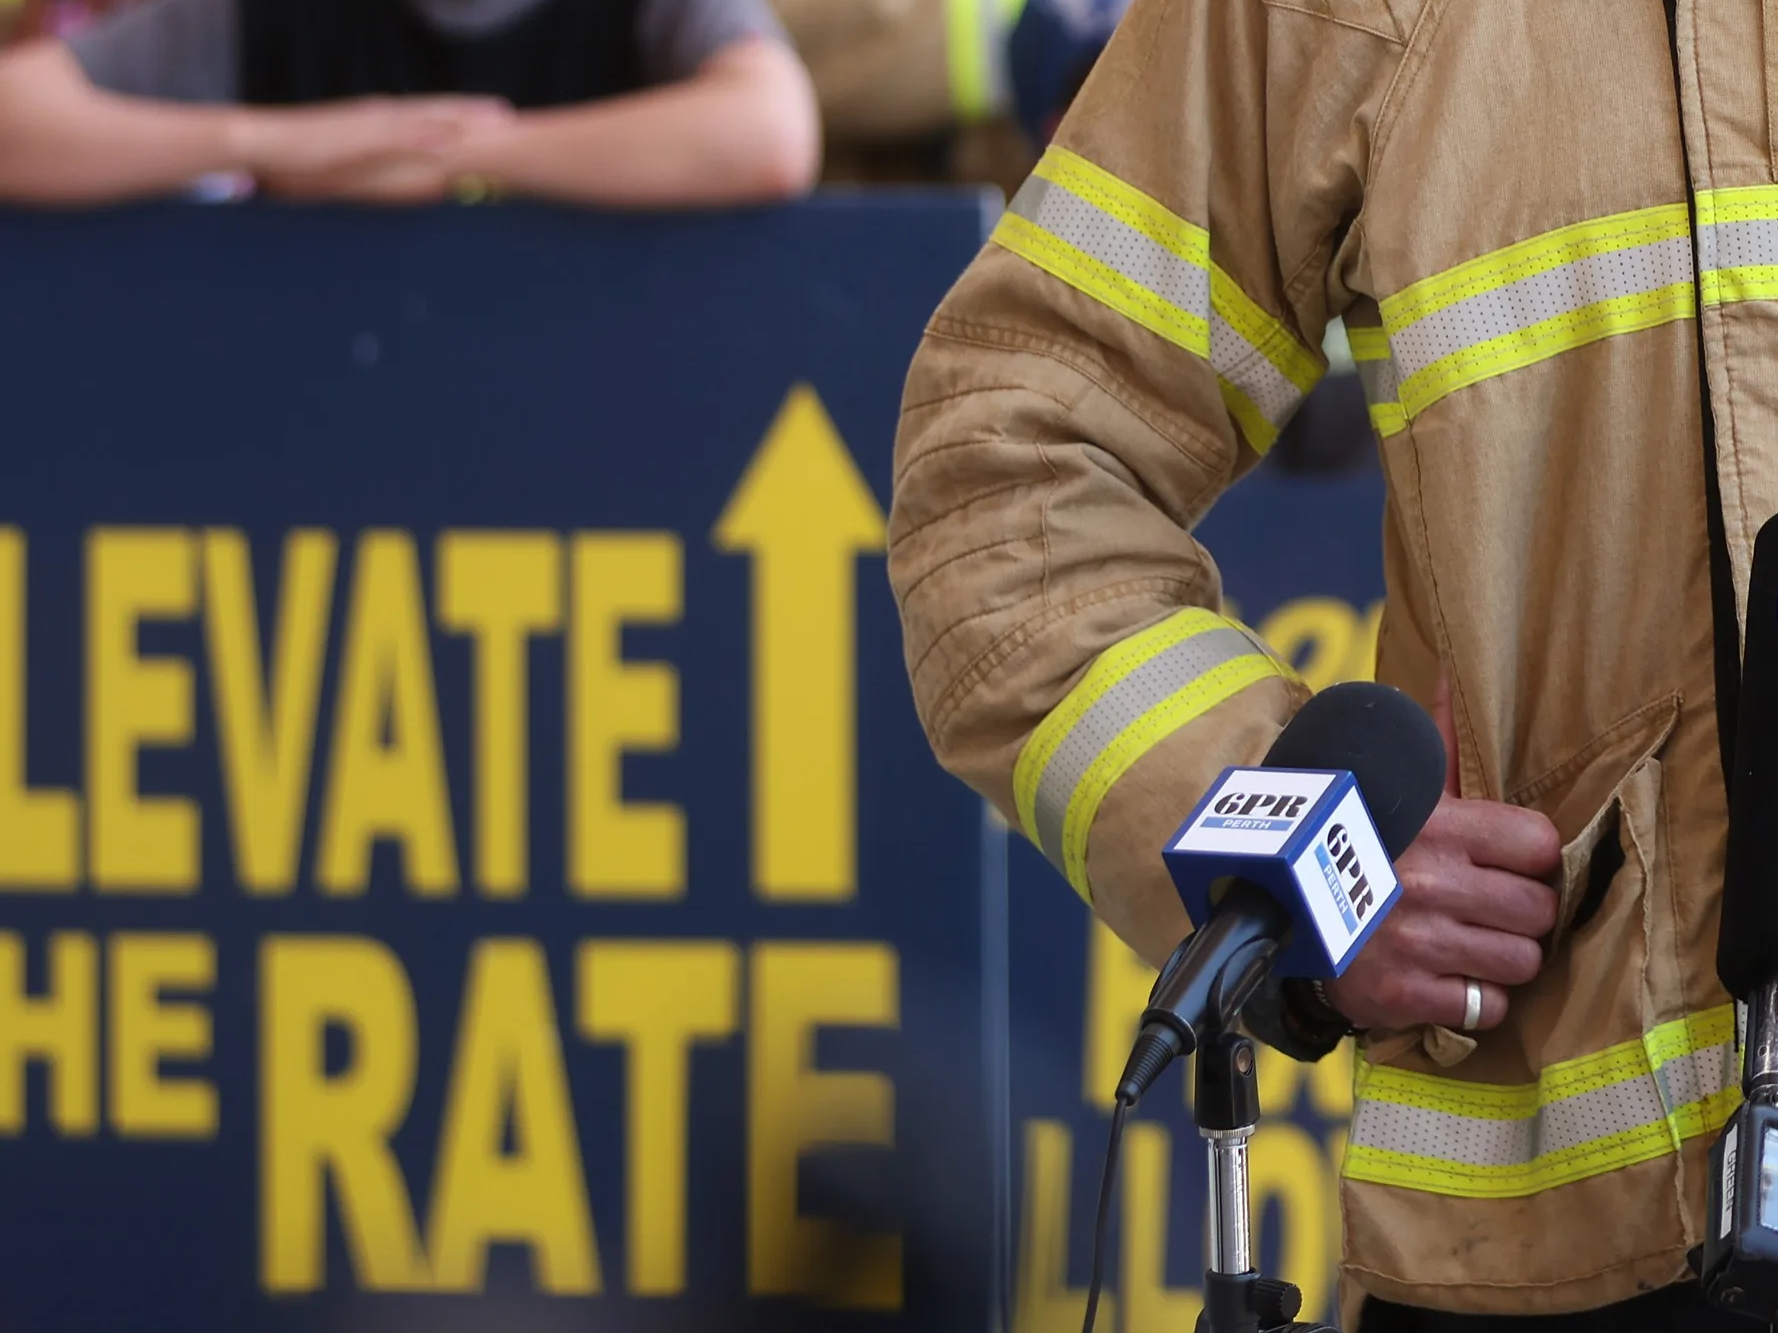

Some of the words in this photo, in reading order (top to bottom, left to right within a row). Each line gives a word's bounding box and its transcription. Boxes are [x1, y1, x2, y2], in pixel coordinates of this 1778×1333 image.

[1213, 792, 1308, 818] 6PR
[1222, 818, 1271, 830] PERTH
[1323, 864, 1349, 916] PERTH
[1327, 822, 1374, 922] 6PR
[258, 932, 905, 1311] RATE
